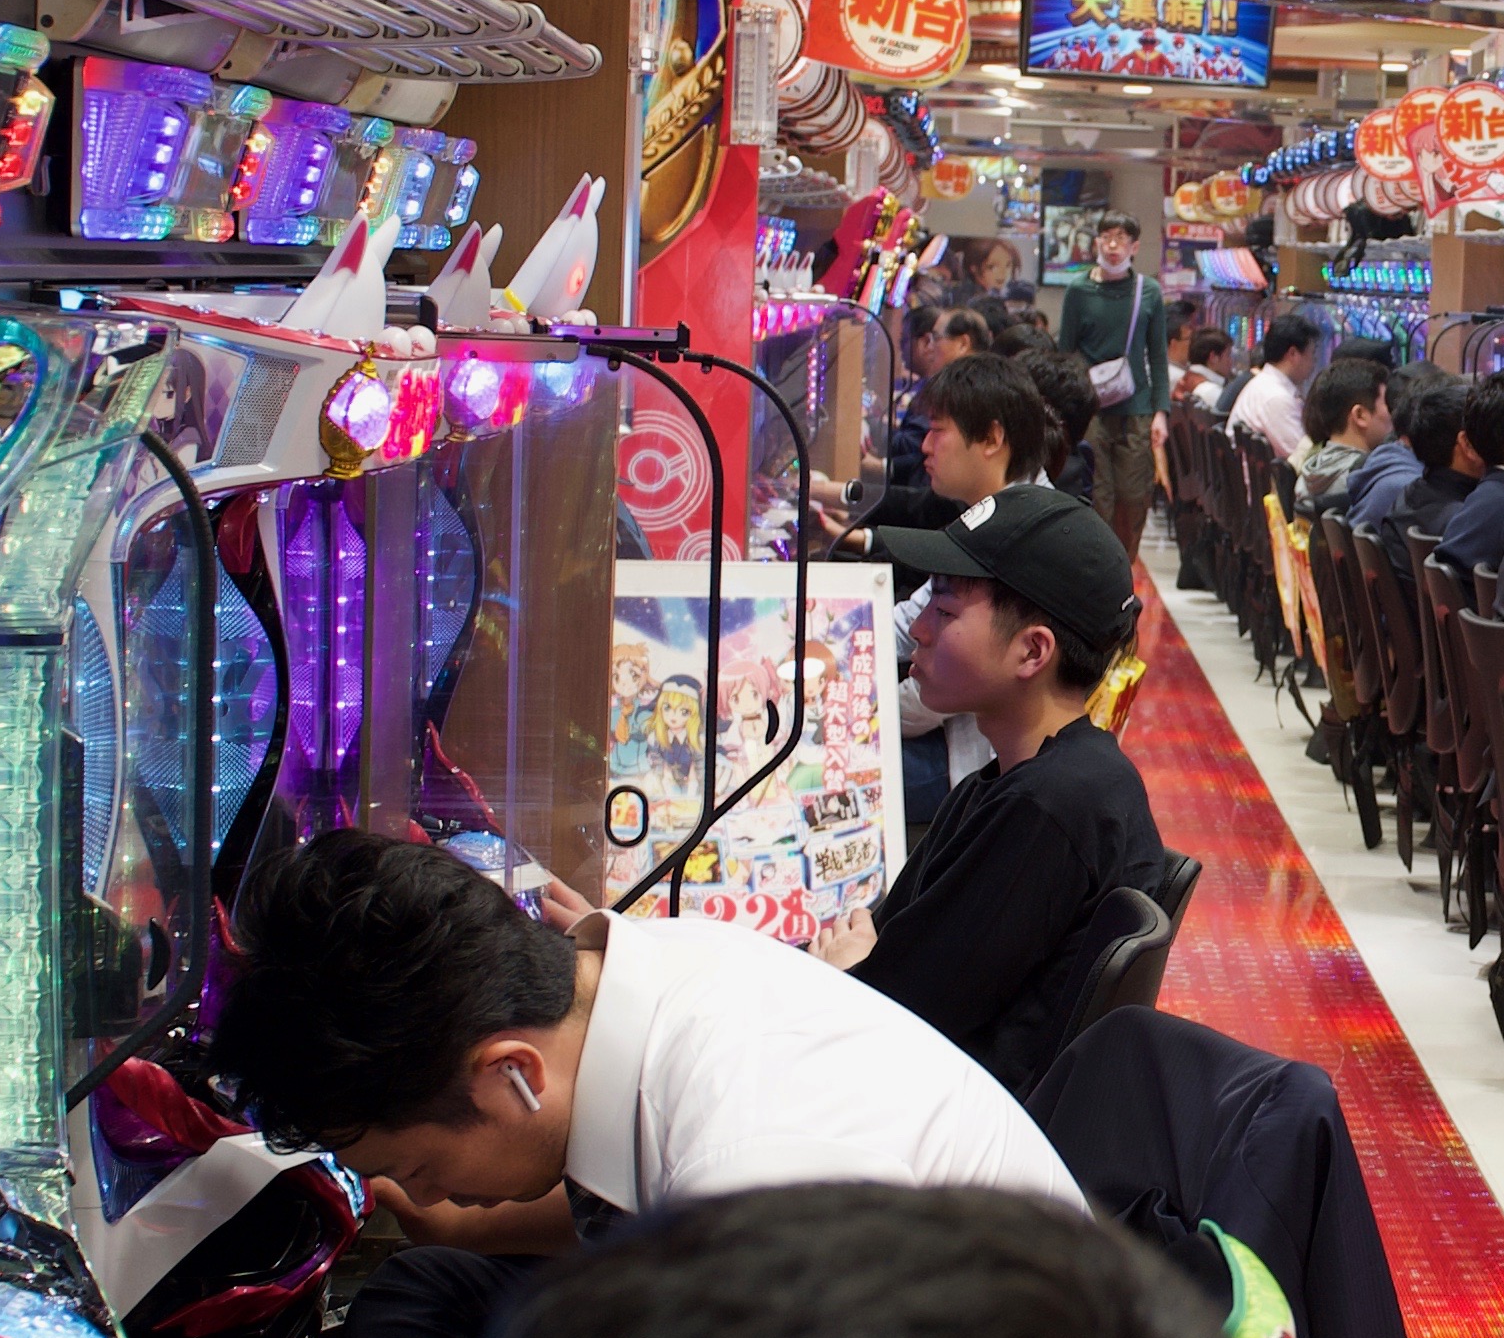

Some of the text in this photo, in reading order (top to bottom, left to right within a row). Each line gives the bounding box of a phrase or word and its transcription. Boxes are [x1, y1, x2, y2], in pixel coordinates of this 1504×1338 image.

[823, 681, 848, 793] 超大型入替
[850, 630, 875, 737] 平成最後の
